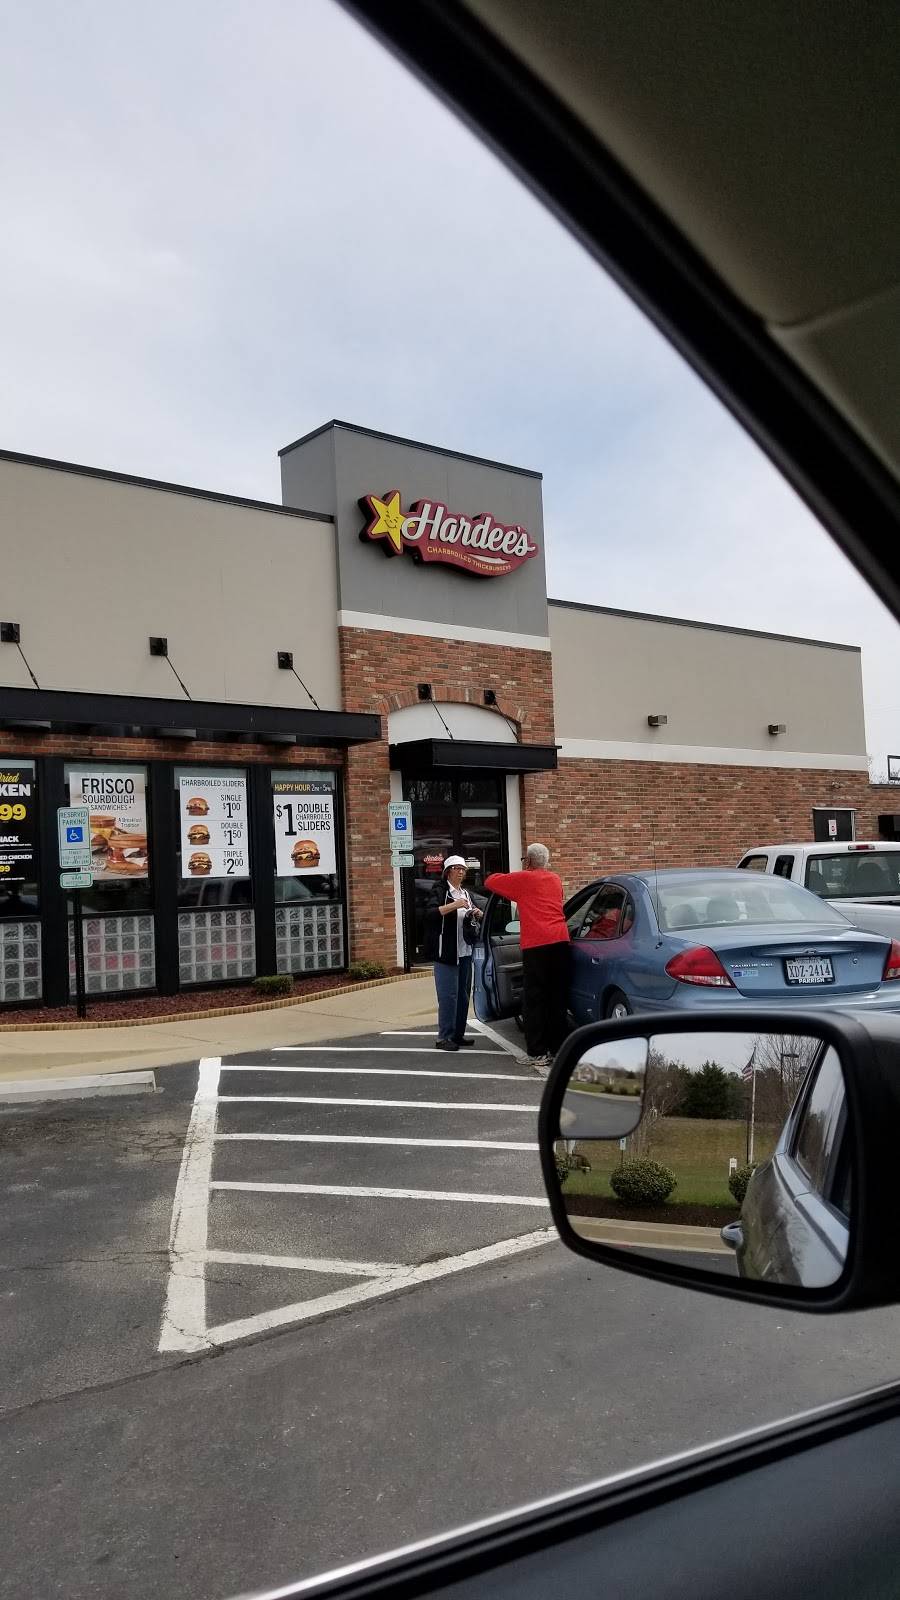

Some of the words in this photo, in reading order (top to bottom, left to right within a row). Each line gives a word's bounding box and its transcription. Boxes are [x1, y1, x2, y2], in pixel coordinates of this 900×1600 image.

[401, 503, 536, 557] Hardee's
[427, 546, 471, 563] CHARBROILED
[81, 778, 134, 794] FRISCO
[181, 779, 222, 787] CHARBROILED
[222, 780, 245, 788] SLIDERS
[0, 784, 31, 797] KEN
[82, 794, 135, 804] SOURDOUGH
[220, 794, 242, 802] SINGLE
[0, 804, 26, 821] 99
[297, 803, 330, 813] DOUBLE
[276, 803, 297, 836] $1
[297, 821, 331, 831] SLIDERS
[787, 964, 831, 978] XDZ-2414
